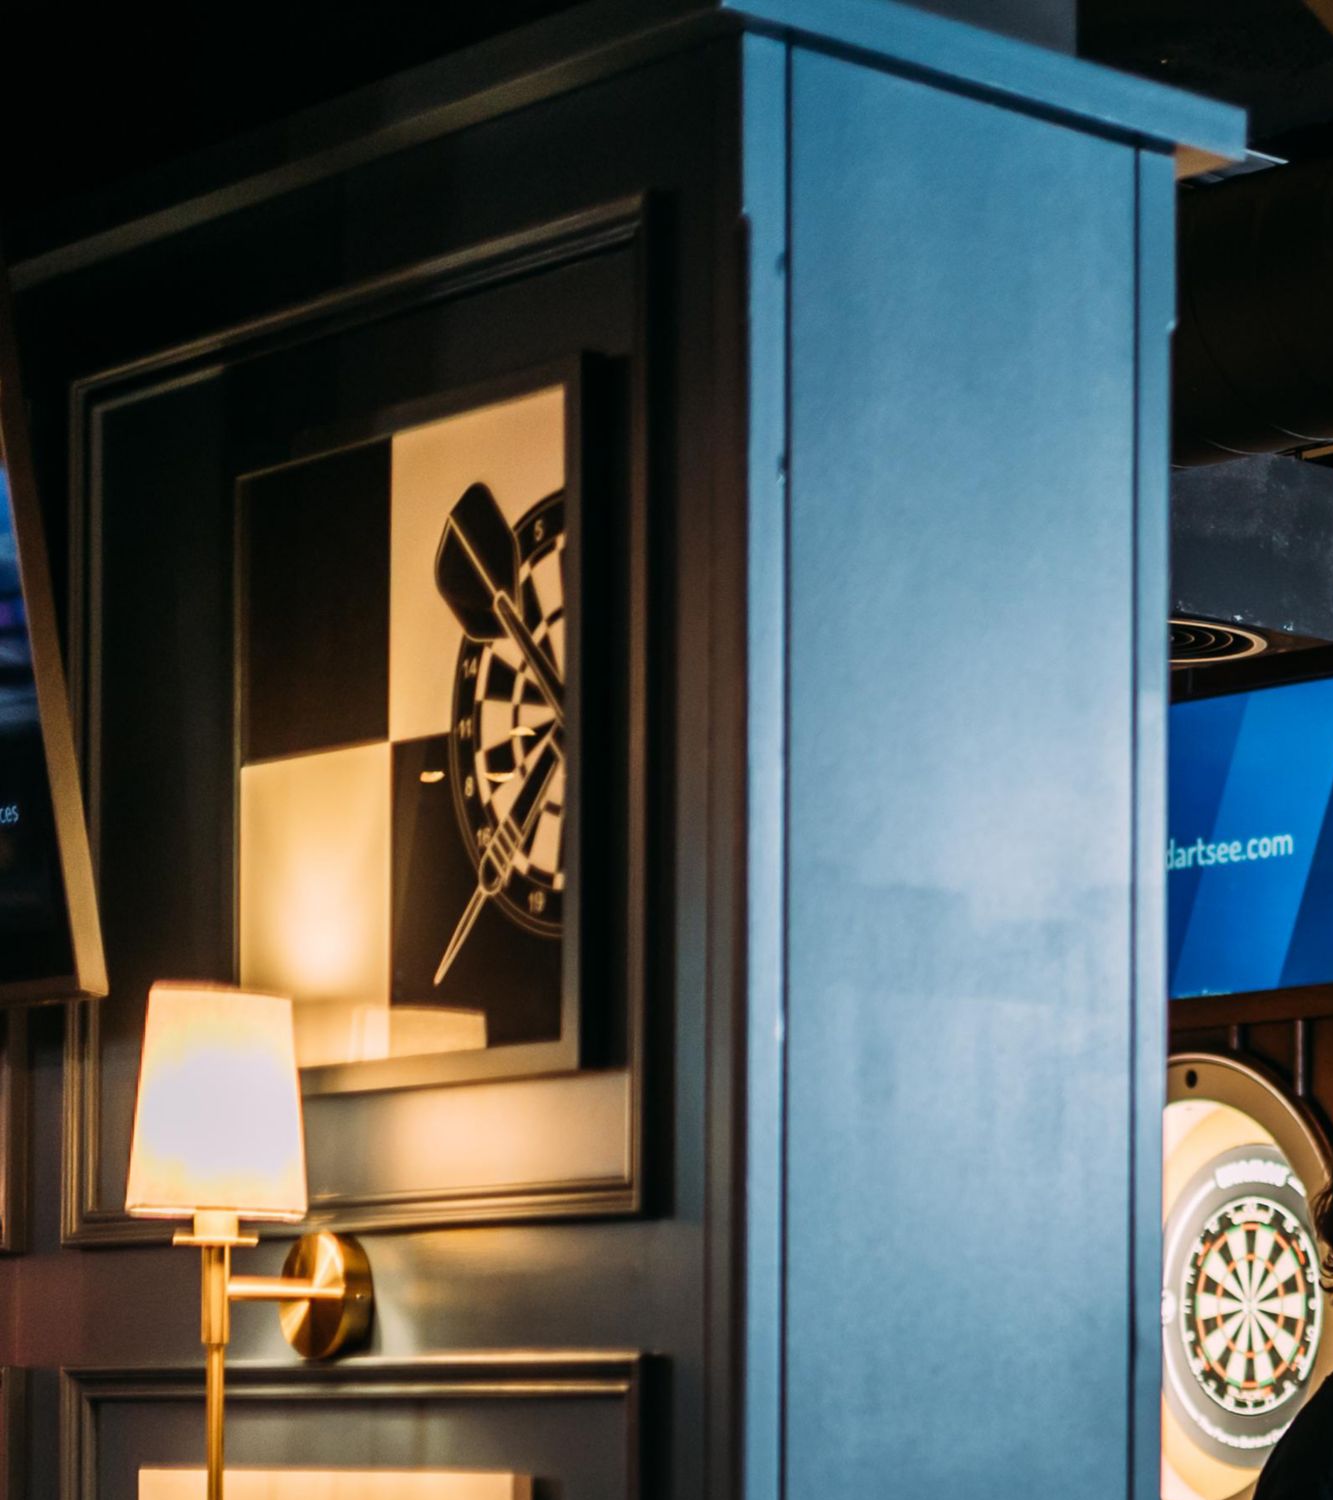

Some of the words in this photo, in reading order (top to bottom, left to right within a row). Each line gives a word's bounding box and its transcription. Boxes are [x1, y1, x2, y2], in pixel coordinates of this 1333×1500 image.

[533, 519, 546, 542] 5
[462, 657, 478, 678] 14
[1166, 833, 1294, 870] dartsee.com
